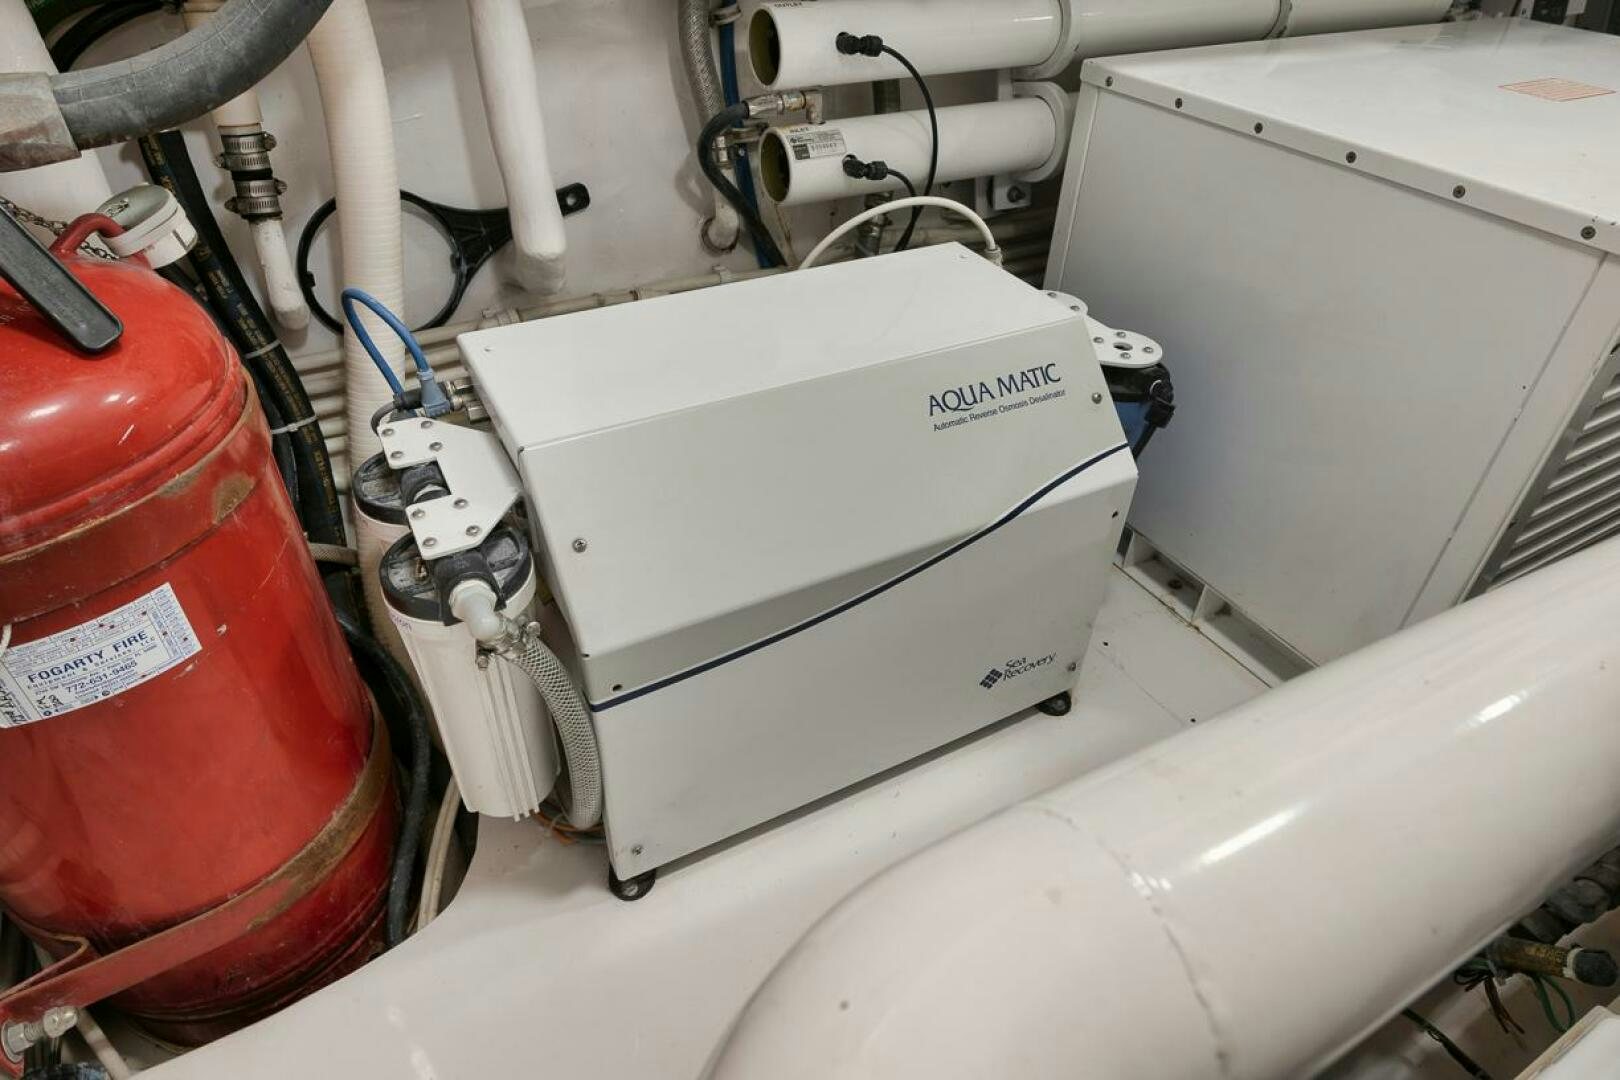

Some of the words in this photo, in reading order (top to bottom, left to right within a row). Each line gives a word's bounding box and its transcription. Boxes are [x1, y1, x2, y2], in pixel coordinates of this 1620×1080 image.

[928, 381, 996, 417] AQUA
[996, 362, 1062, 398] MATIC
[933, 416, 969, 432] Automatic
[969, 408, 998, 422] Reverse
[998, 400, 1029, 414] Osmosis
[1029, 388, 1066, 406] Desalinator
[28, 650, 104, 683] FOGARTY
[112, 630, 148, 653] FIRE
[1003, 651, 1057, 681] Recovery
[1006, 657, 1027, 668] Sea
